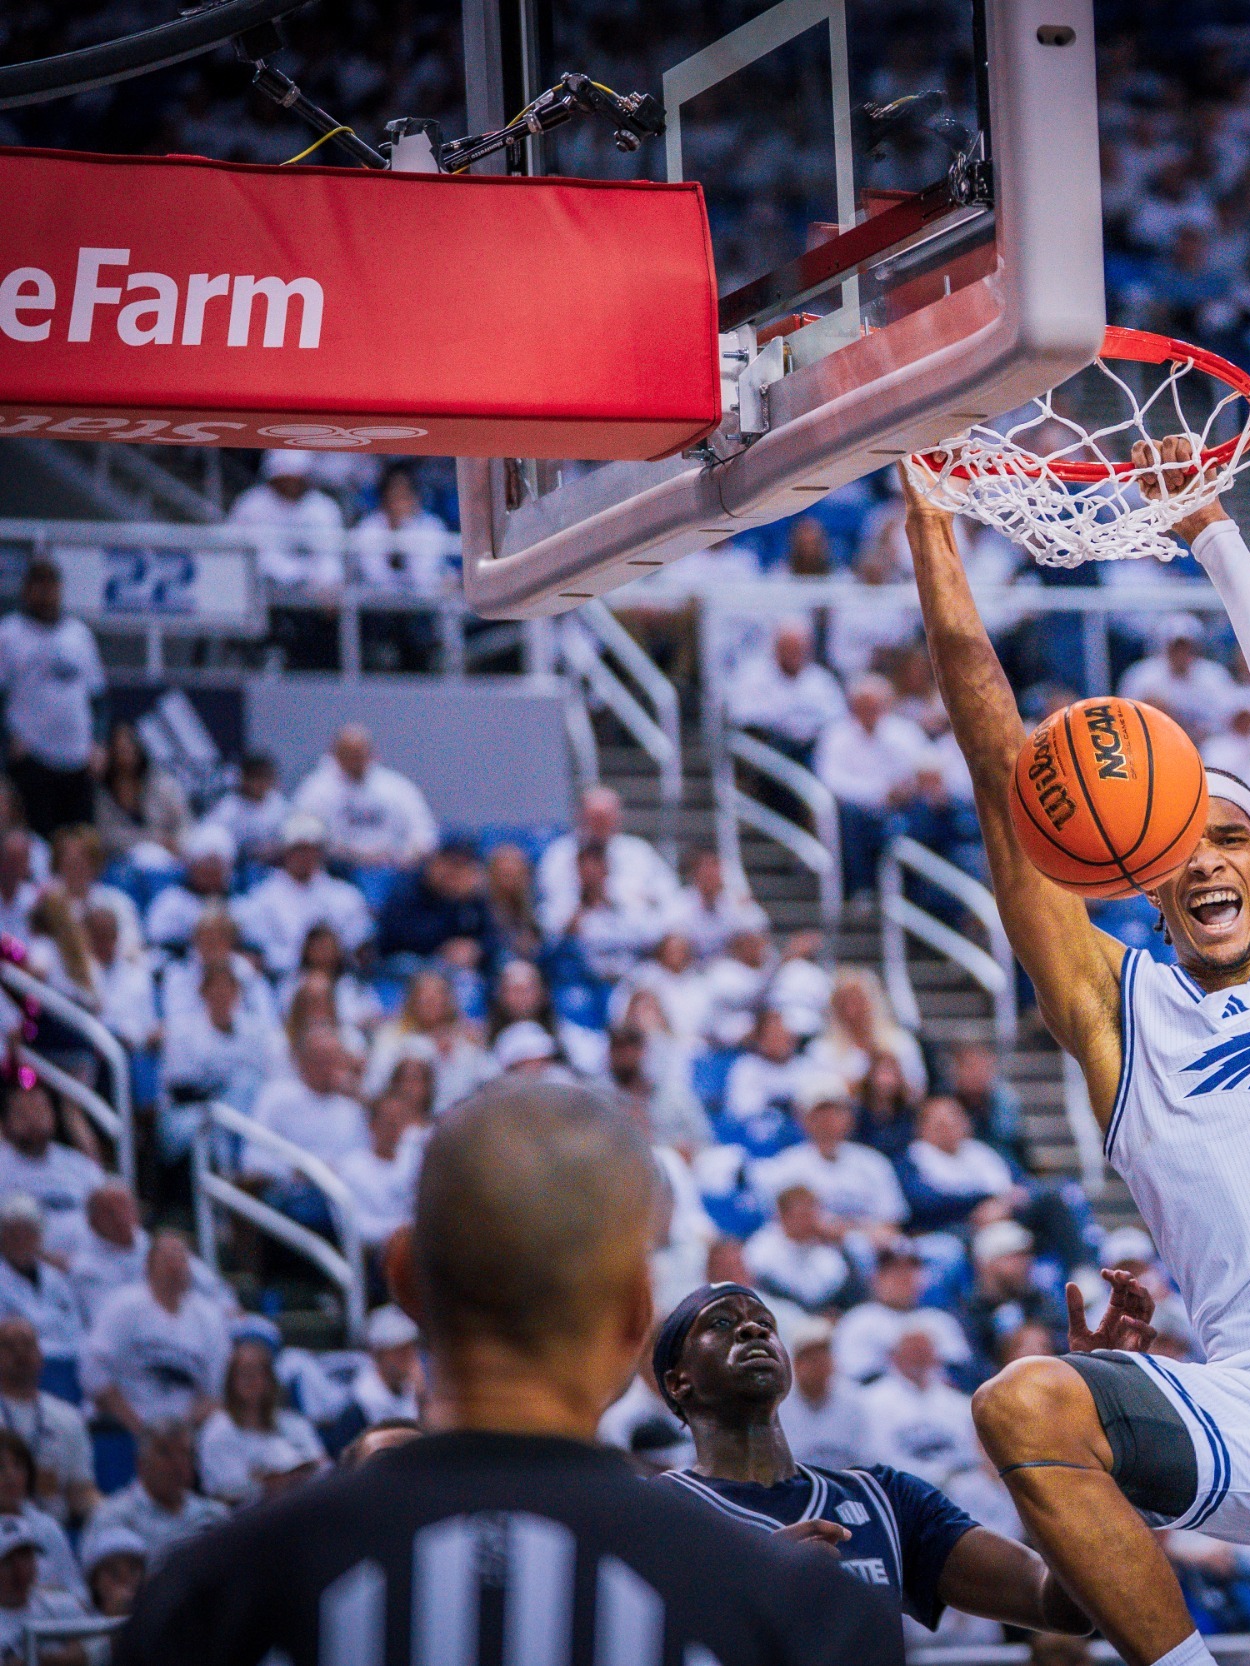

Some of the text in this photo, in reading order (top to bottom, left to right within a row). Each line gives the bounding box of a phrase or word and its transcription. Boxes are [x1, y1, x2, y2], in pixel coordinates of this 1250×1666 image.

[0, 415, 248, 442] Stat
[101, 548, 197, 614] 22
[1083, 704, 1129, 781] NCAA
